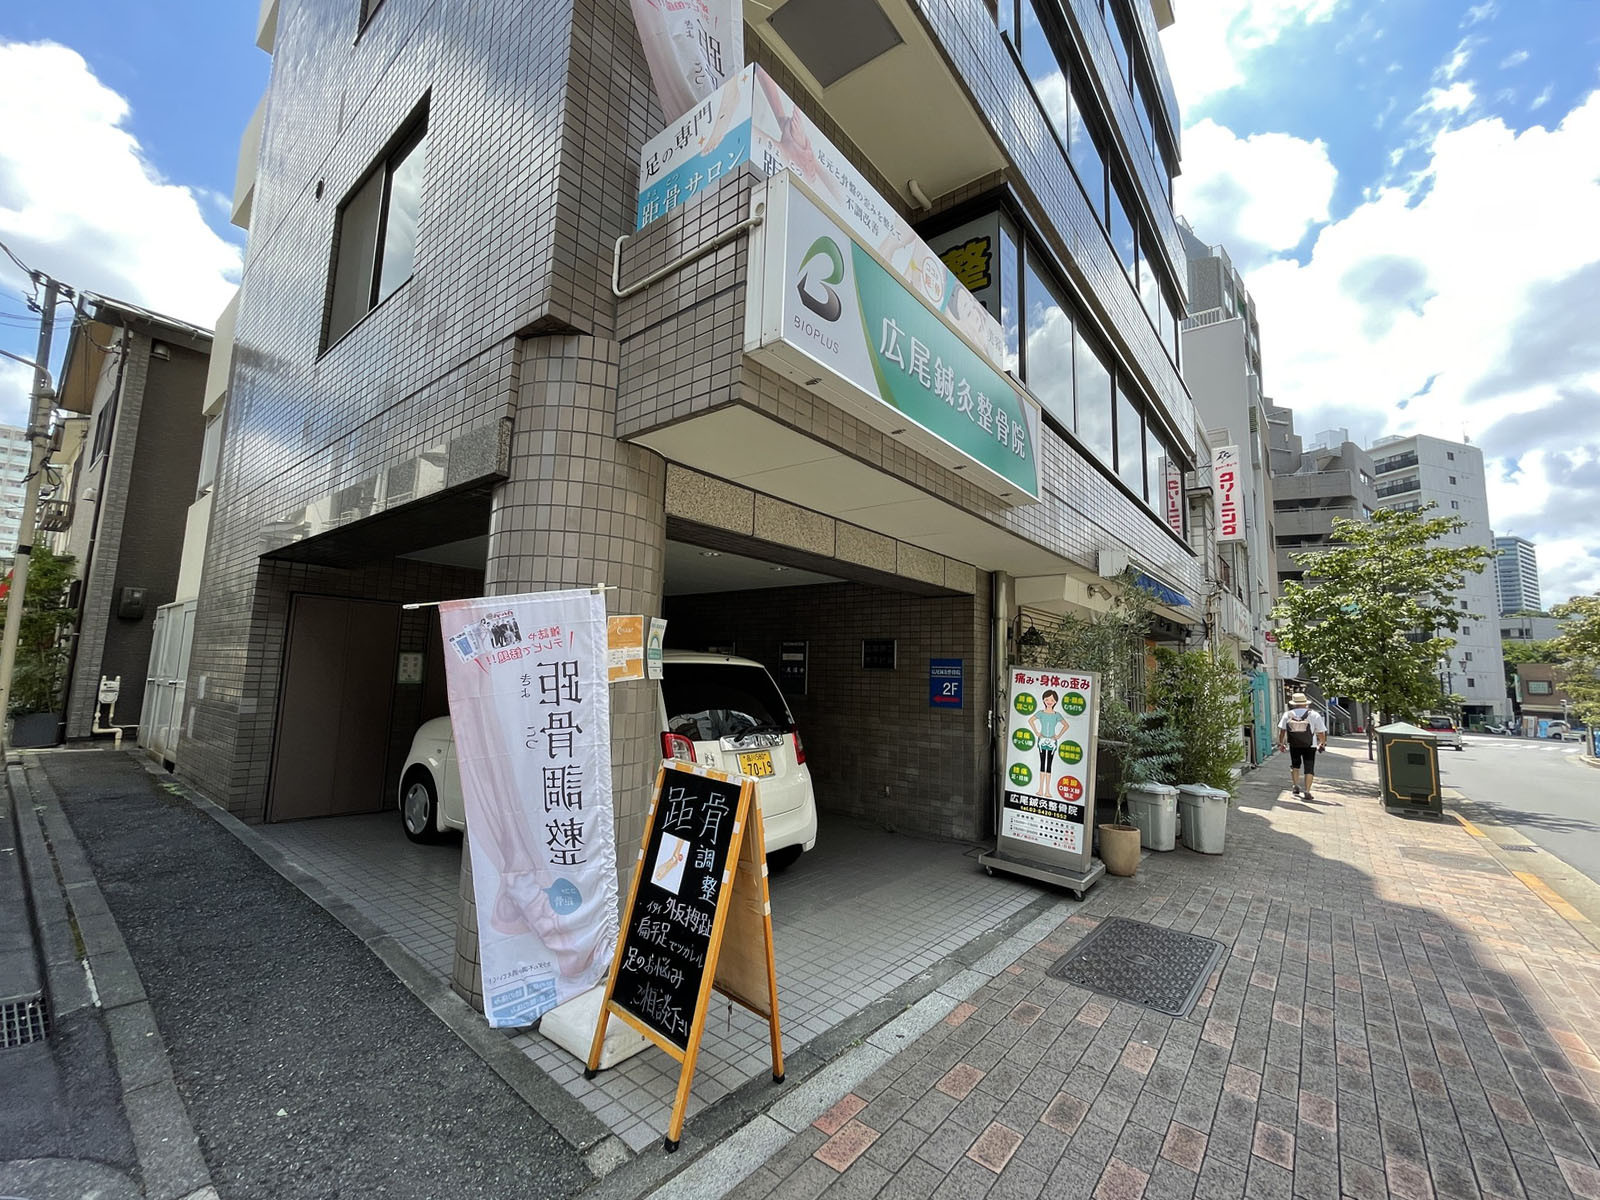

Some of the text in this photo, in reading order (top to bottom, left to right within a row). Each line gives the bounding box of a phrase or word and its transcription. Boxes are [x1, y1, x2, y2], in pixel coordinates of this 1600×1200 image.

[645, 101, 713, 182] 足の専門
[641, 144, 745, 229] 距骨サロン
[793, 314, 840, 355] BIOPLUS
[879, 316, 1027, 460] 広尾鍼灸整骨院
[1219, 471, 1237, 536] クリーニング
[942, 682, 959, 696] 2F
[1014, 672, 1091, 691] 痛み・身体の歪み
[661, 786, 729, 845] 距骨
[1009, 794, 1079, 816] 広尾鍼灸整骨院
[694, 845, 718, 907] 調整
[622, 946, 685, 989] 足のお悩み
